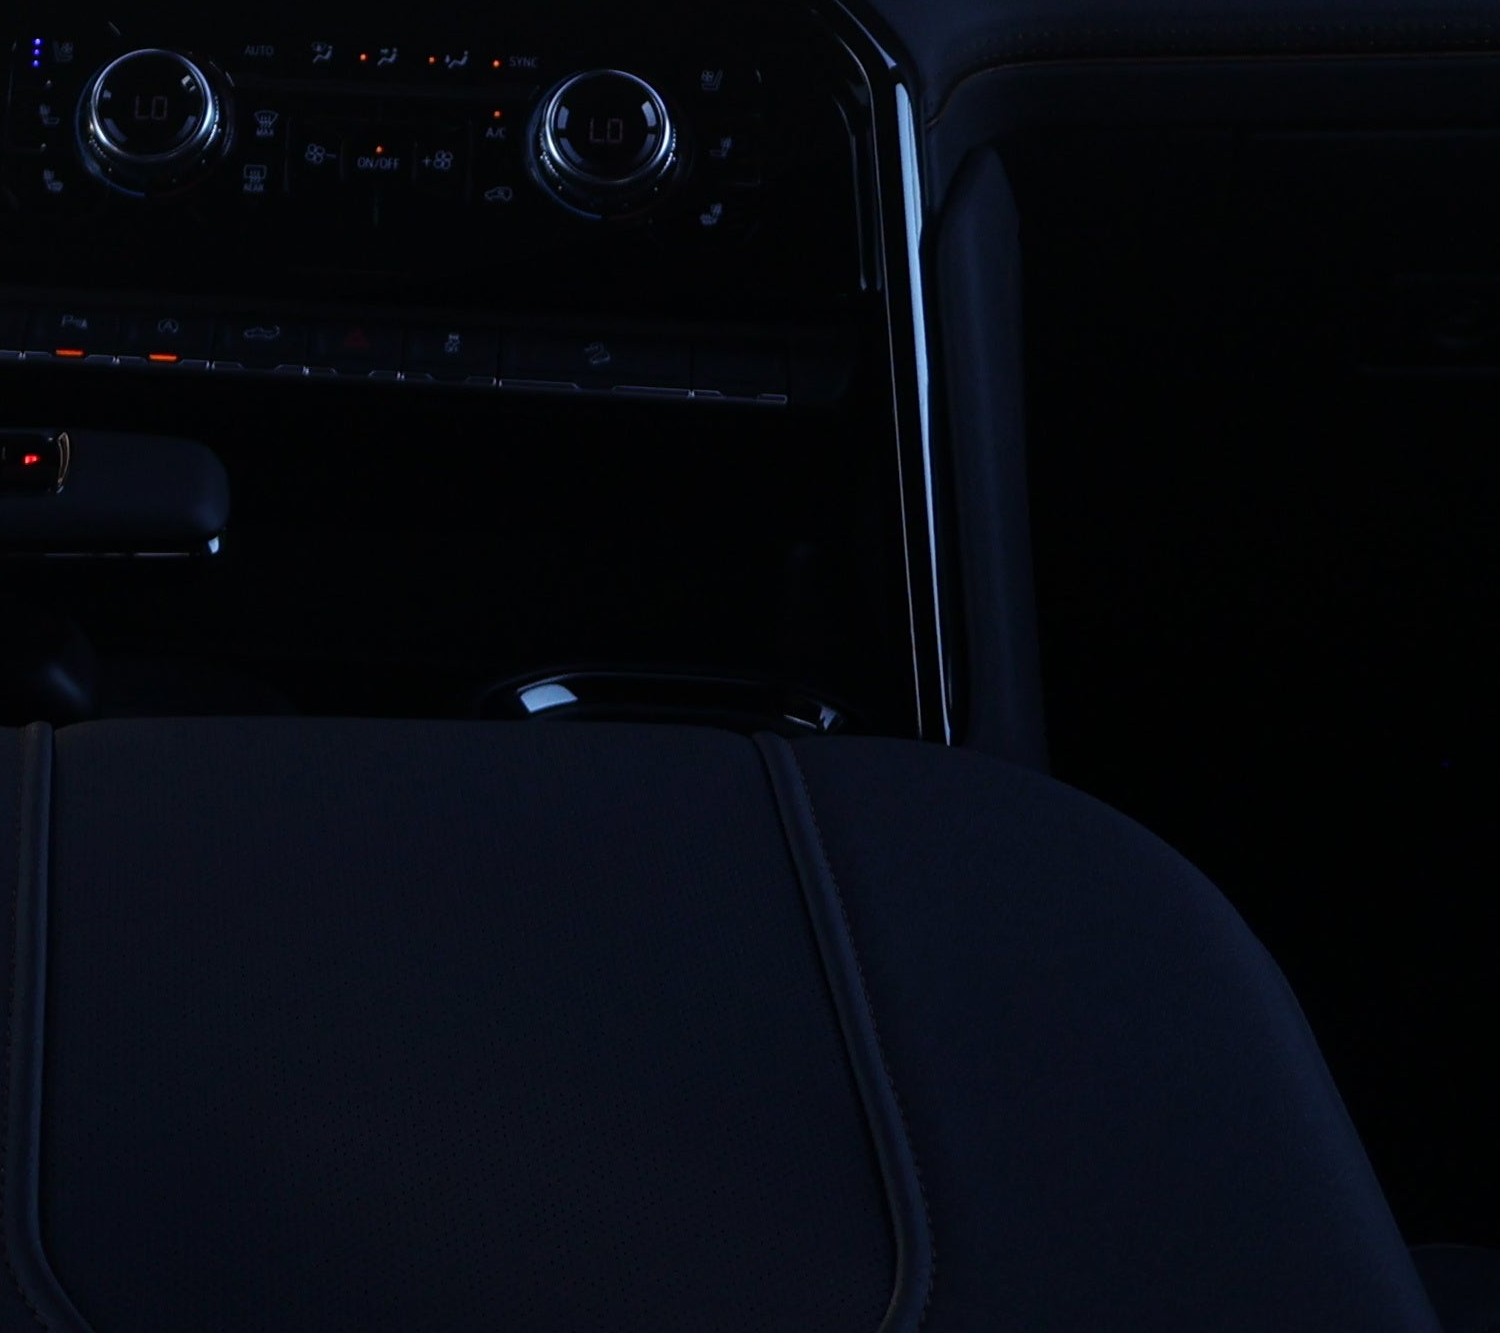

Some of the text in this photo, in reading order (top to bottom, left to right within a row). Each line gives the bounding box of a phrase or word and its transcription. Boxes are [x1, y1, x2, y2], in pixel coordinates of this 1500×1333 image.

[244, 44, 274, 57] AUTO
[508, 55, 539, 68] SYNC
[484, 127, 507, 140] A/C
[357, 157, 400, 171] ON/OFF
